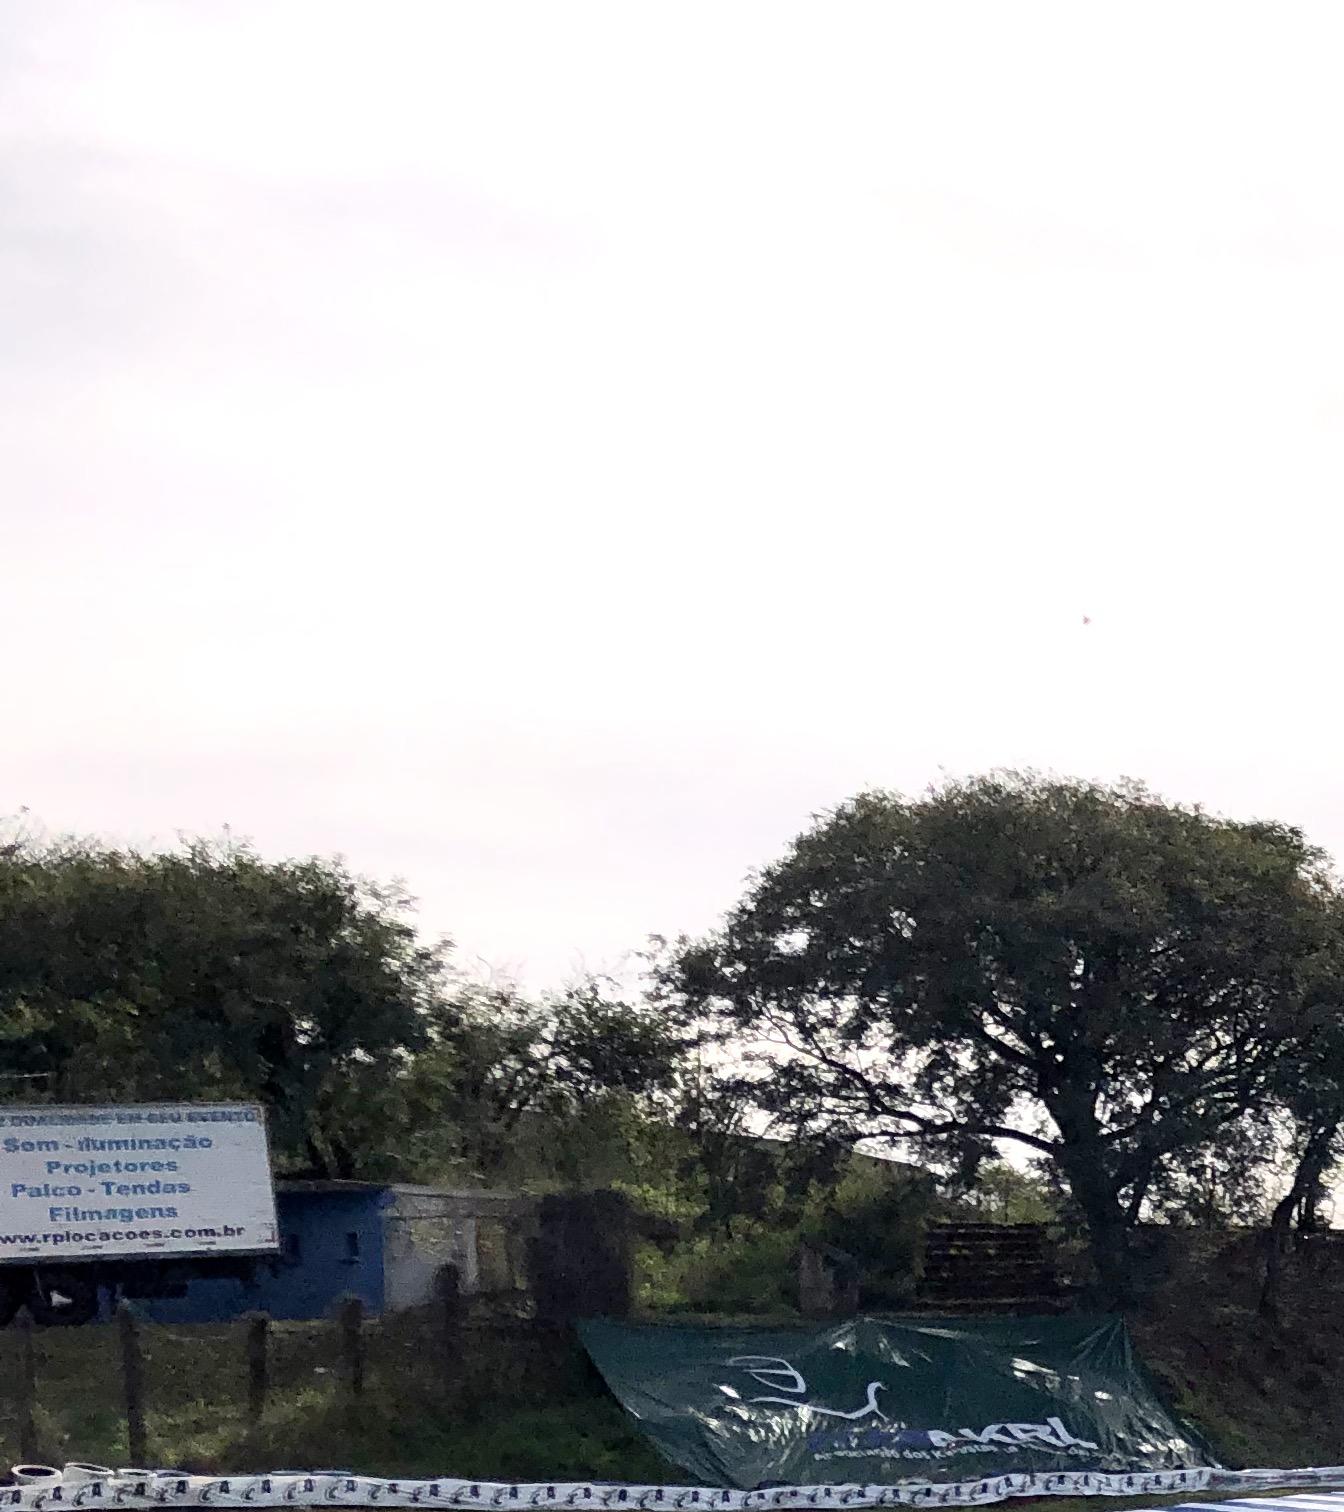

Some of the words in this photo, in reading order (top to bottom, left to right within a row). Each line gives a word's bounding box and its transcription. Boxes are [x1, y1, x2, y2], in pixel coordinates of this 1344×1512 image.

[3, 1137, 60, 1153] Som
[46, 1160, 179, 1177] Projetores
[11, 1183, 82, 1198] Palco
[101, 1180, 190, 1197] Tendas
[50, 1205, 179, 1223] Filmagens
